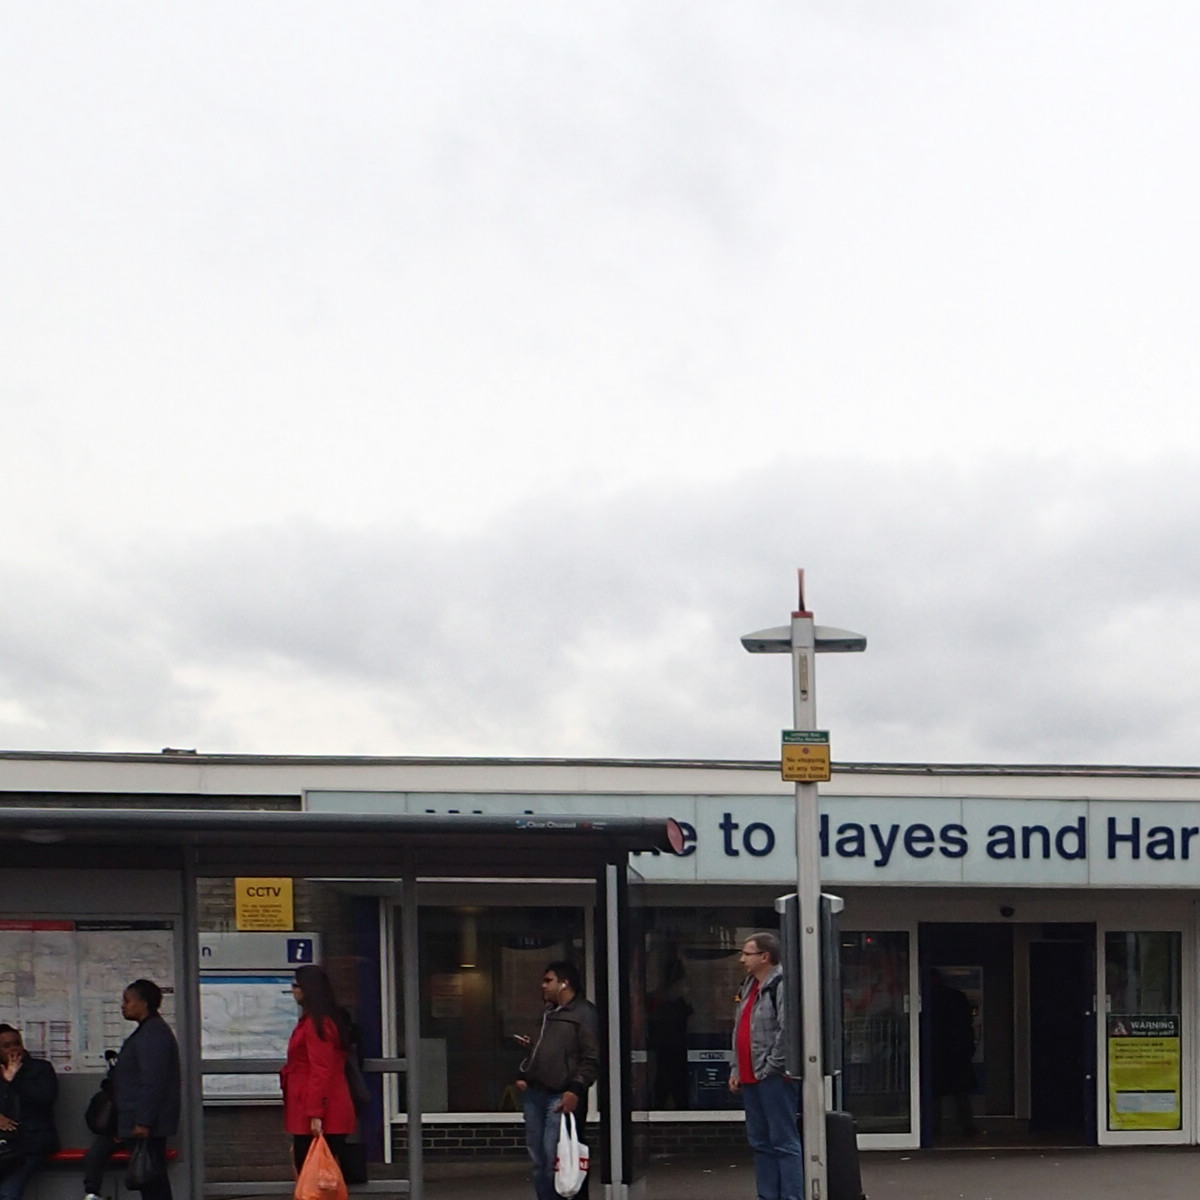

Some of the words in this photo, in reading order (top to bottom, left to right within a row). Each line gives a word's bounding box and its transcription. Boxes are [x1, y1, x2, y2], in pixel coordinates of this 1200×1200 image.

[719, 812, 776, 857] to
[986, 815, 1088, 861] and
[246, 886, 282, 897] CCTV
[1131, 1020, 1175, 1030] WARNING
